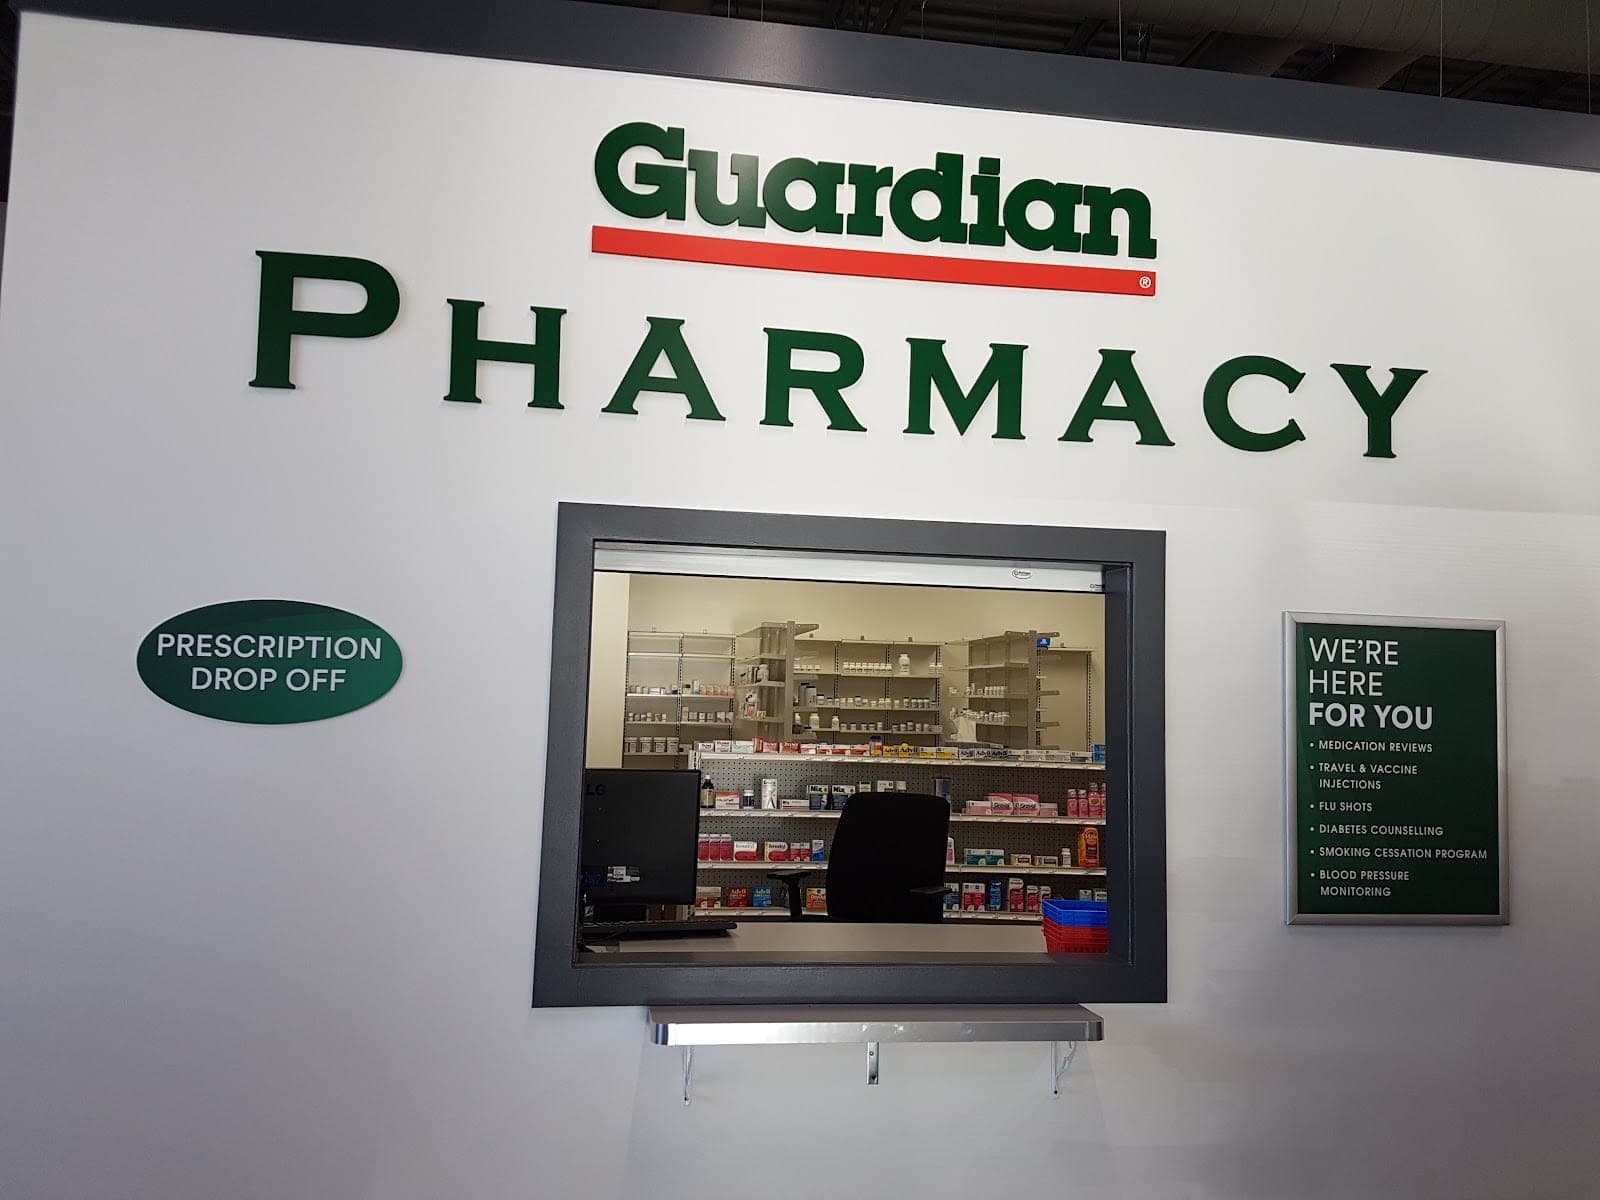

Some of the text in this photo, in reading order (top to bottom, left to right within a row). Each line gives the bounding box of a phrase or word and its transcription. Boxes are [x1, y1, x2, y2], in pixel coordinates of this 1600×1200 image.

[595, 121, 1157, 259] Guardian
[249, 250, 1428, 458] PHARMACY
[158, 633, 381, 659] PRESCRIPTION
[1309, 638, 1399, 665] WE'RE
[191, 667, 346, 691] DROP OFF
[1309, 669, 1383, 696] HERE
[1309, 702, 1432, 730] FOR YOU
[1319, 740, 1432, 753] MEDICATION REVIEWS
[1319, 763, 1418, 774] TRAVEL & VACCINE
[1319, 779, 1382, 790] INJECTIONS
[1319, 802, 1373, 812] FLU SHOTS
[1319, 824, 1444, 836] DIABETES COUNSELLING
[1319, 847, 1487, 859] SMOKING CESSATION PROGRAM
[1319, 870, 1410, 880] BLOOD PRESSURE
[1320, 886, 1392, 896] MONITORING
